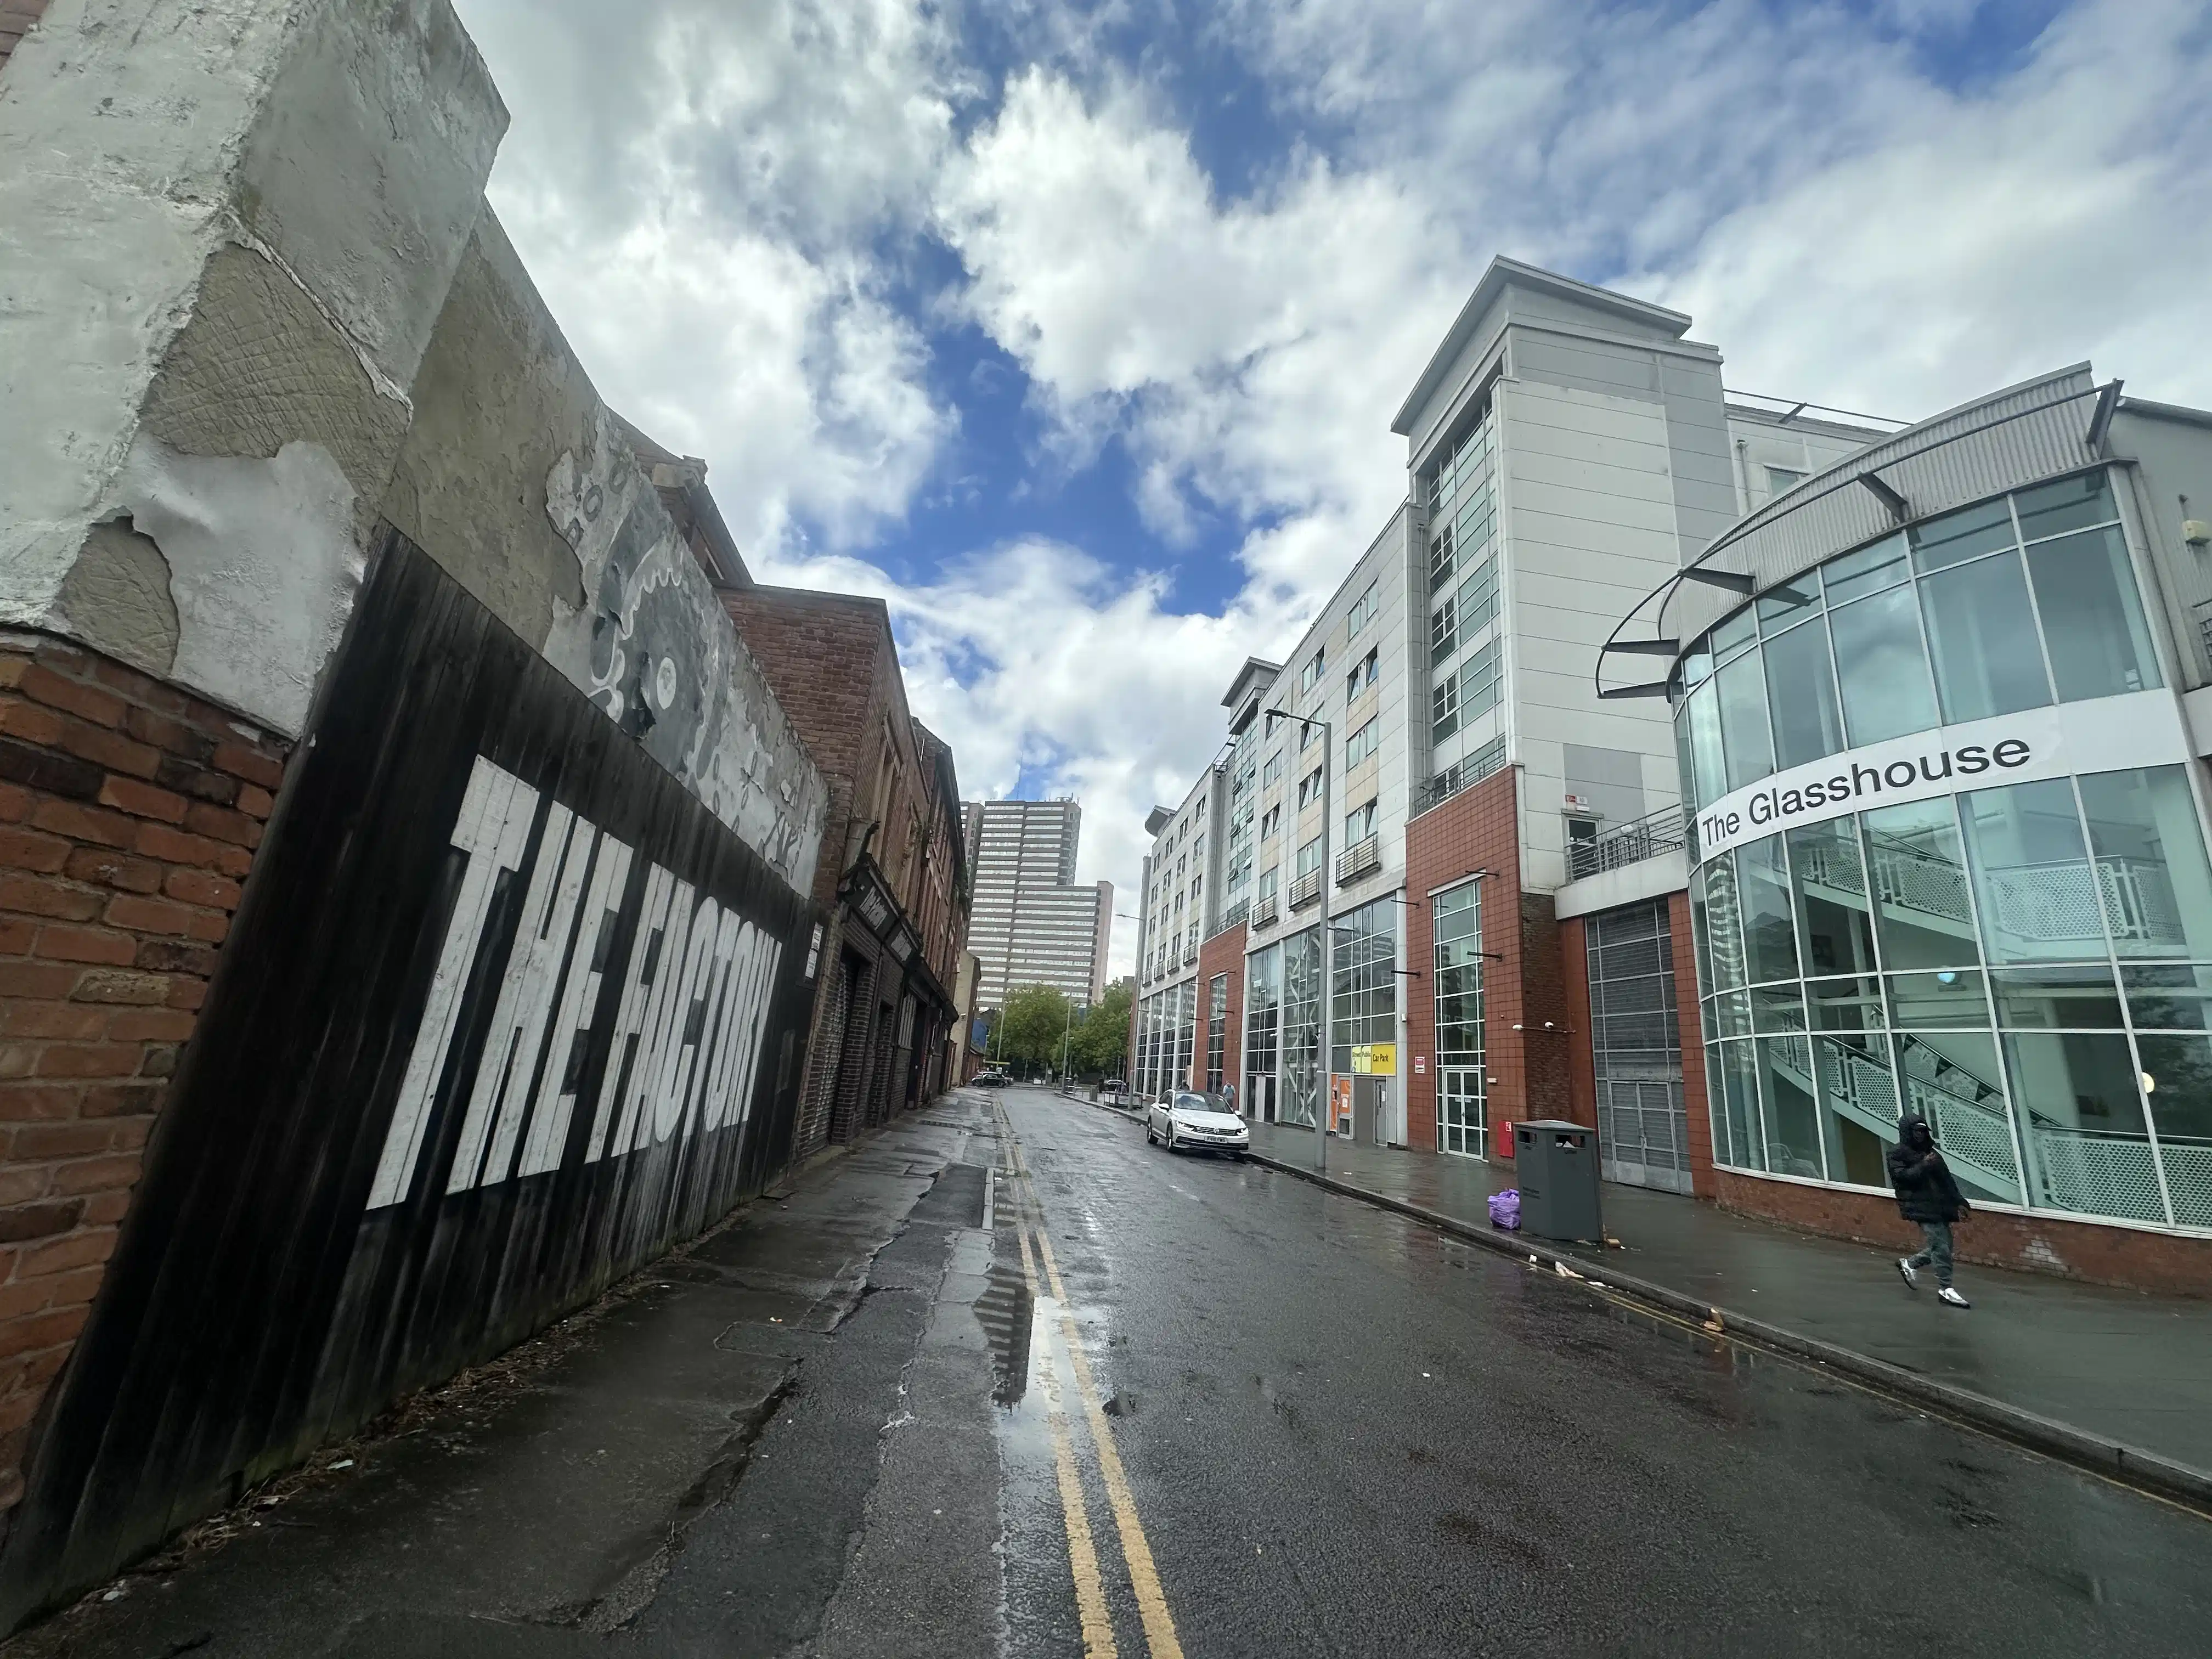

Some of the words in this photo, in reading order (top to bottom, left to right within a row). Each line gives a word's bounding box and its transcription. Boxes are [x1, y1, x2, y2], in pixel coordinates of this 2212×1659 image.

[1703, 812, 1740, 846] The
[1748, 738, 2030, 825] Glasshouse
[365, 754, 634, 1211] THE
[584, 861, 782, 1164] FACTORY
[1380, 1053, 1389, 1062] Park
